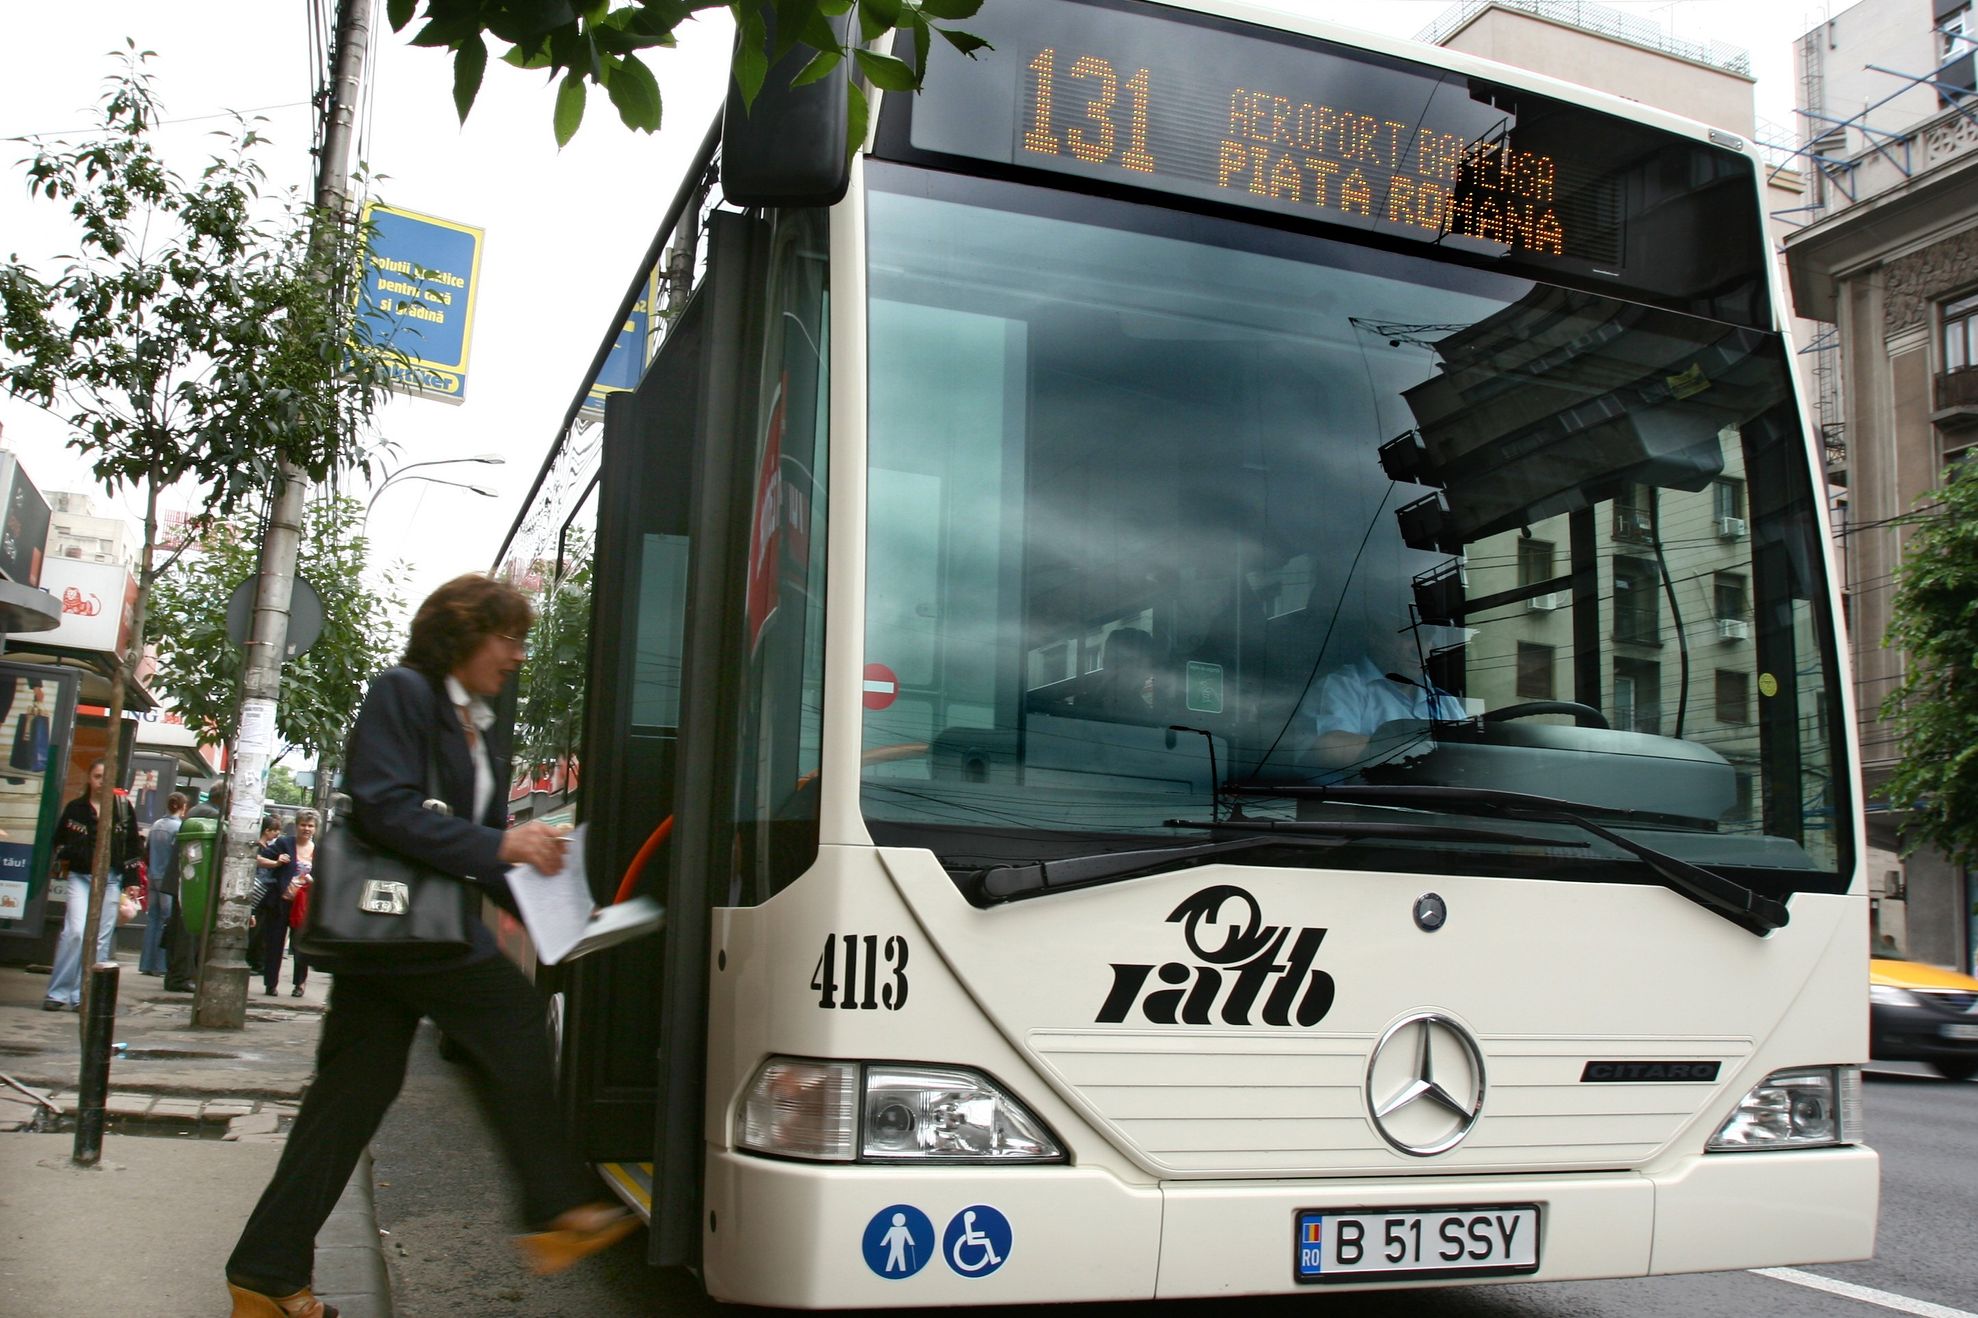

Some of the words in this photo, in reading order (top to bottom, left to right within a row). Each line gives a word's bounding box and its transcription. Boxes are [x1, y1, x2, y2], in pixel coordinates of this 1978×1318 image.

[1024, 47, 1154, 173] 131
[1229, 87, 1408, 169] AEROPORT
[1418, 127, 1555, 201] BANEASA
[1218, 138, 1371, 216] PIATA
[1389, 172, 1563, 255] ROMANA
[377, 278, 421, 298] pentru
[379, 298, 393, 312] si
[3, 858, 26, 868] tău!
[810, 933, 909, 1011] 4113
[1589, 1064, 1714, 1078] CITARO
[1336, 1219, 1365, 1265] B
[1384, 1218, 1421, 1263] 51
[1438, 1214, 1521, 1262] SSY
[1301, 1248, 1320, 1267] RO
